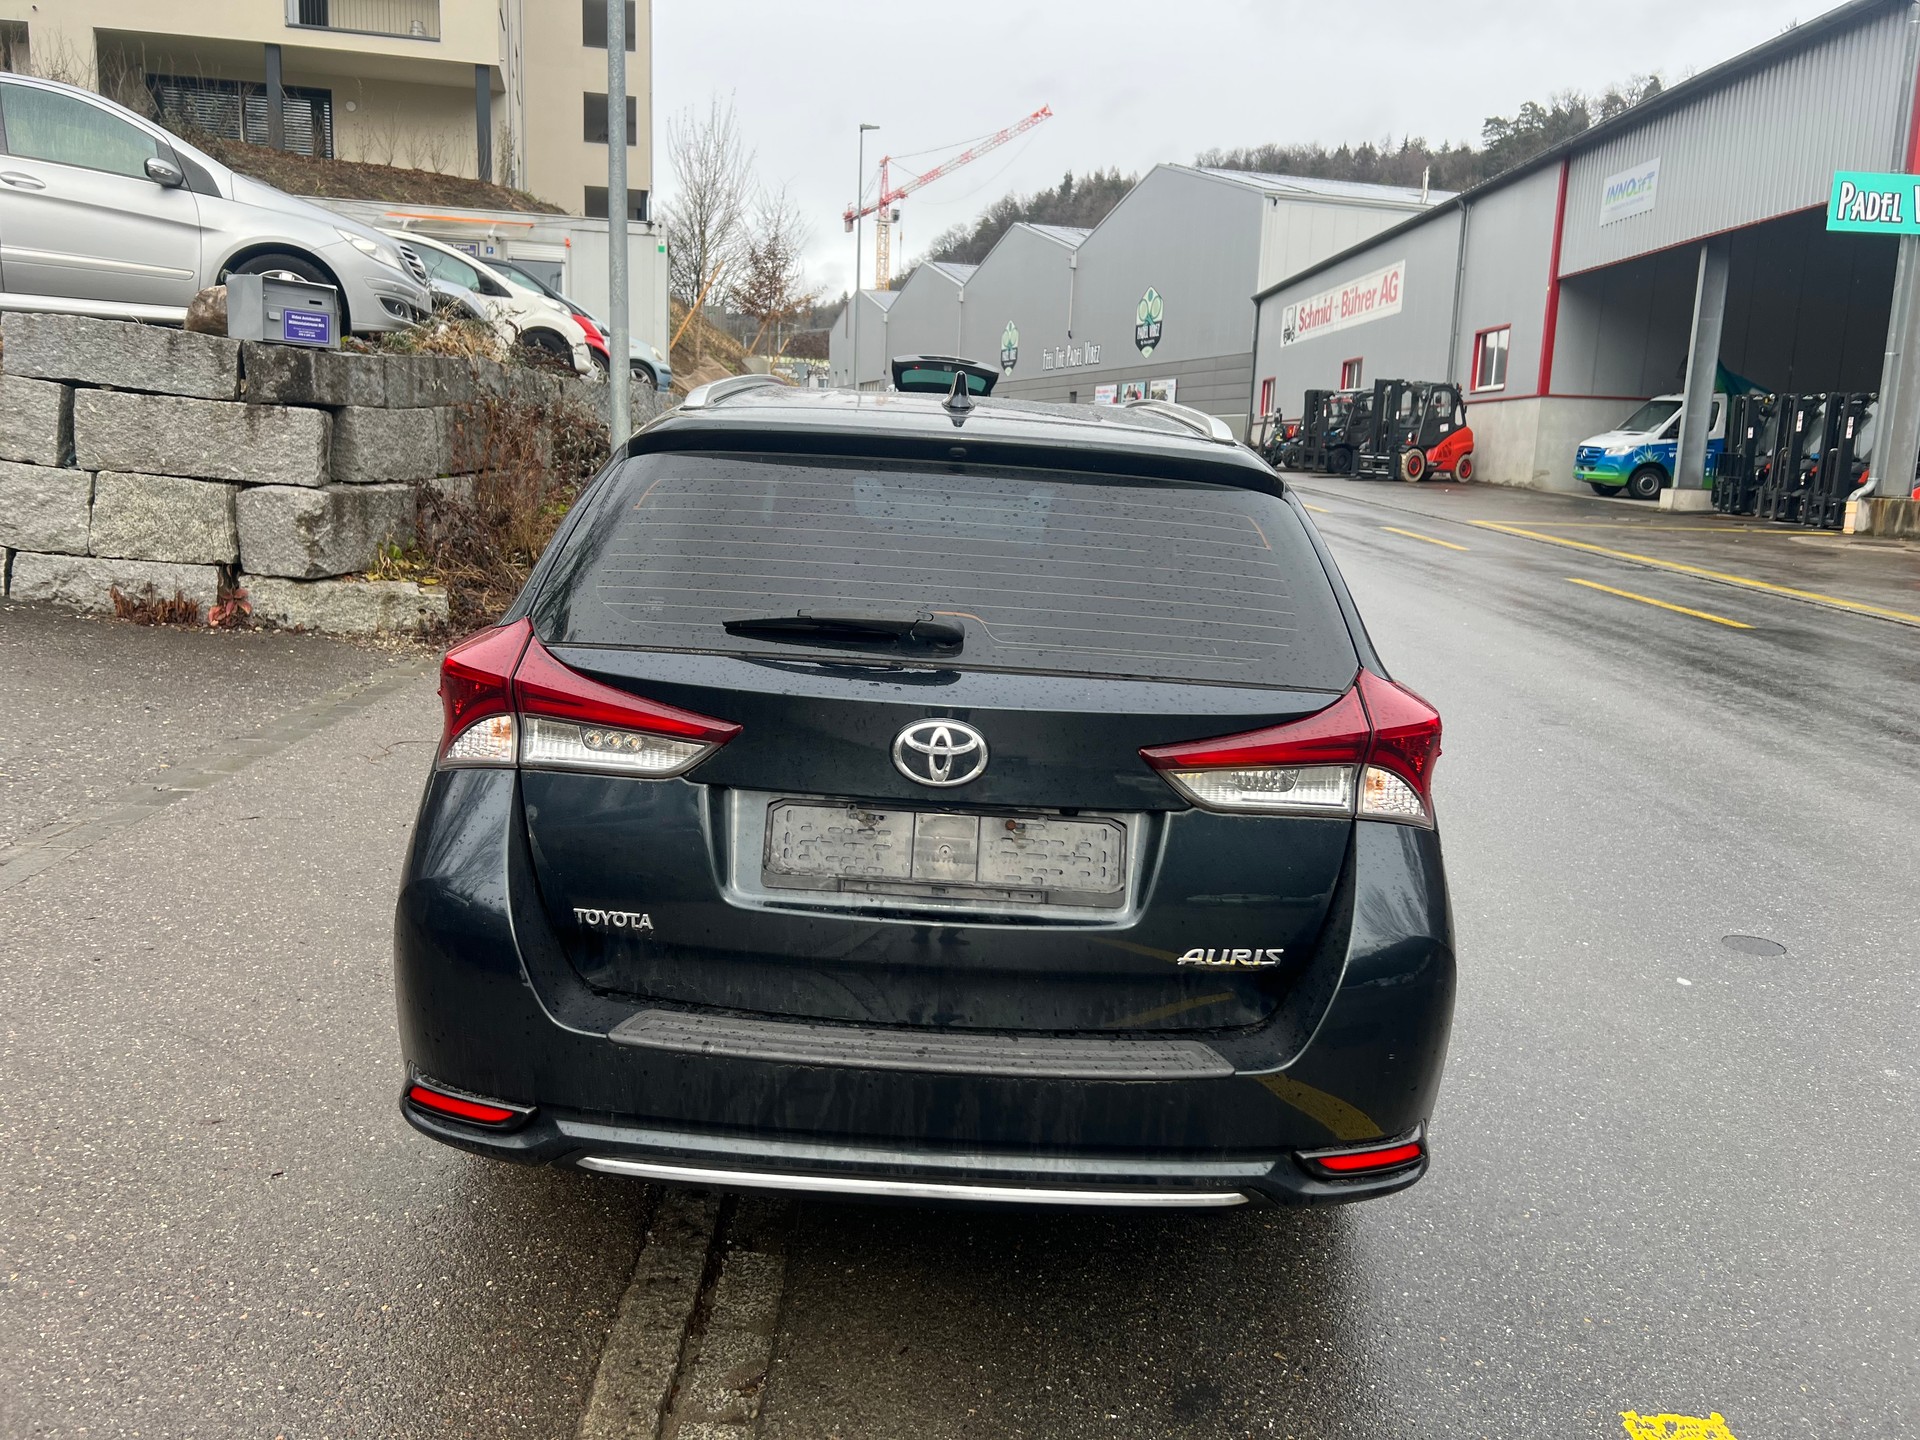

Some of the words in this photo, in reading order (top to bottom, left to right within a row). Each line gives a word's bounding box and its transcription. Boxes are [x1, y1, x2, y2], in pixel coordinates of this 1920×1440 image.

[1837, 181, 1903, 223] PADEL
[1298, 296, 1333, 332] Schmid
[1341, 286, 1377, 318] Bührer
[1379, 271, 1399, 306] AG
[573, 907, 654, 930] TOYOTA
[1177, 948, 1284, 966] AURIS
